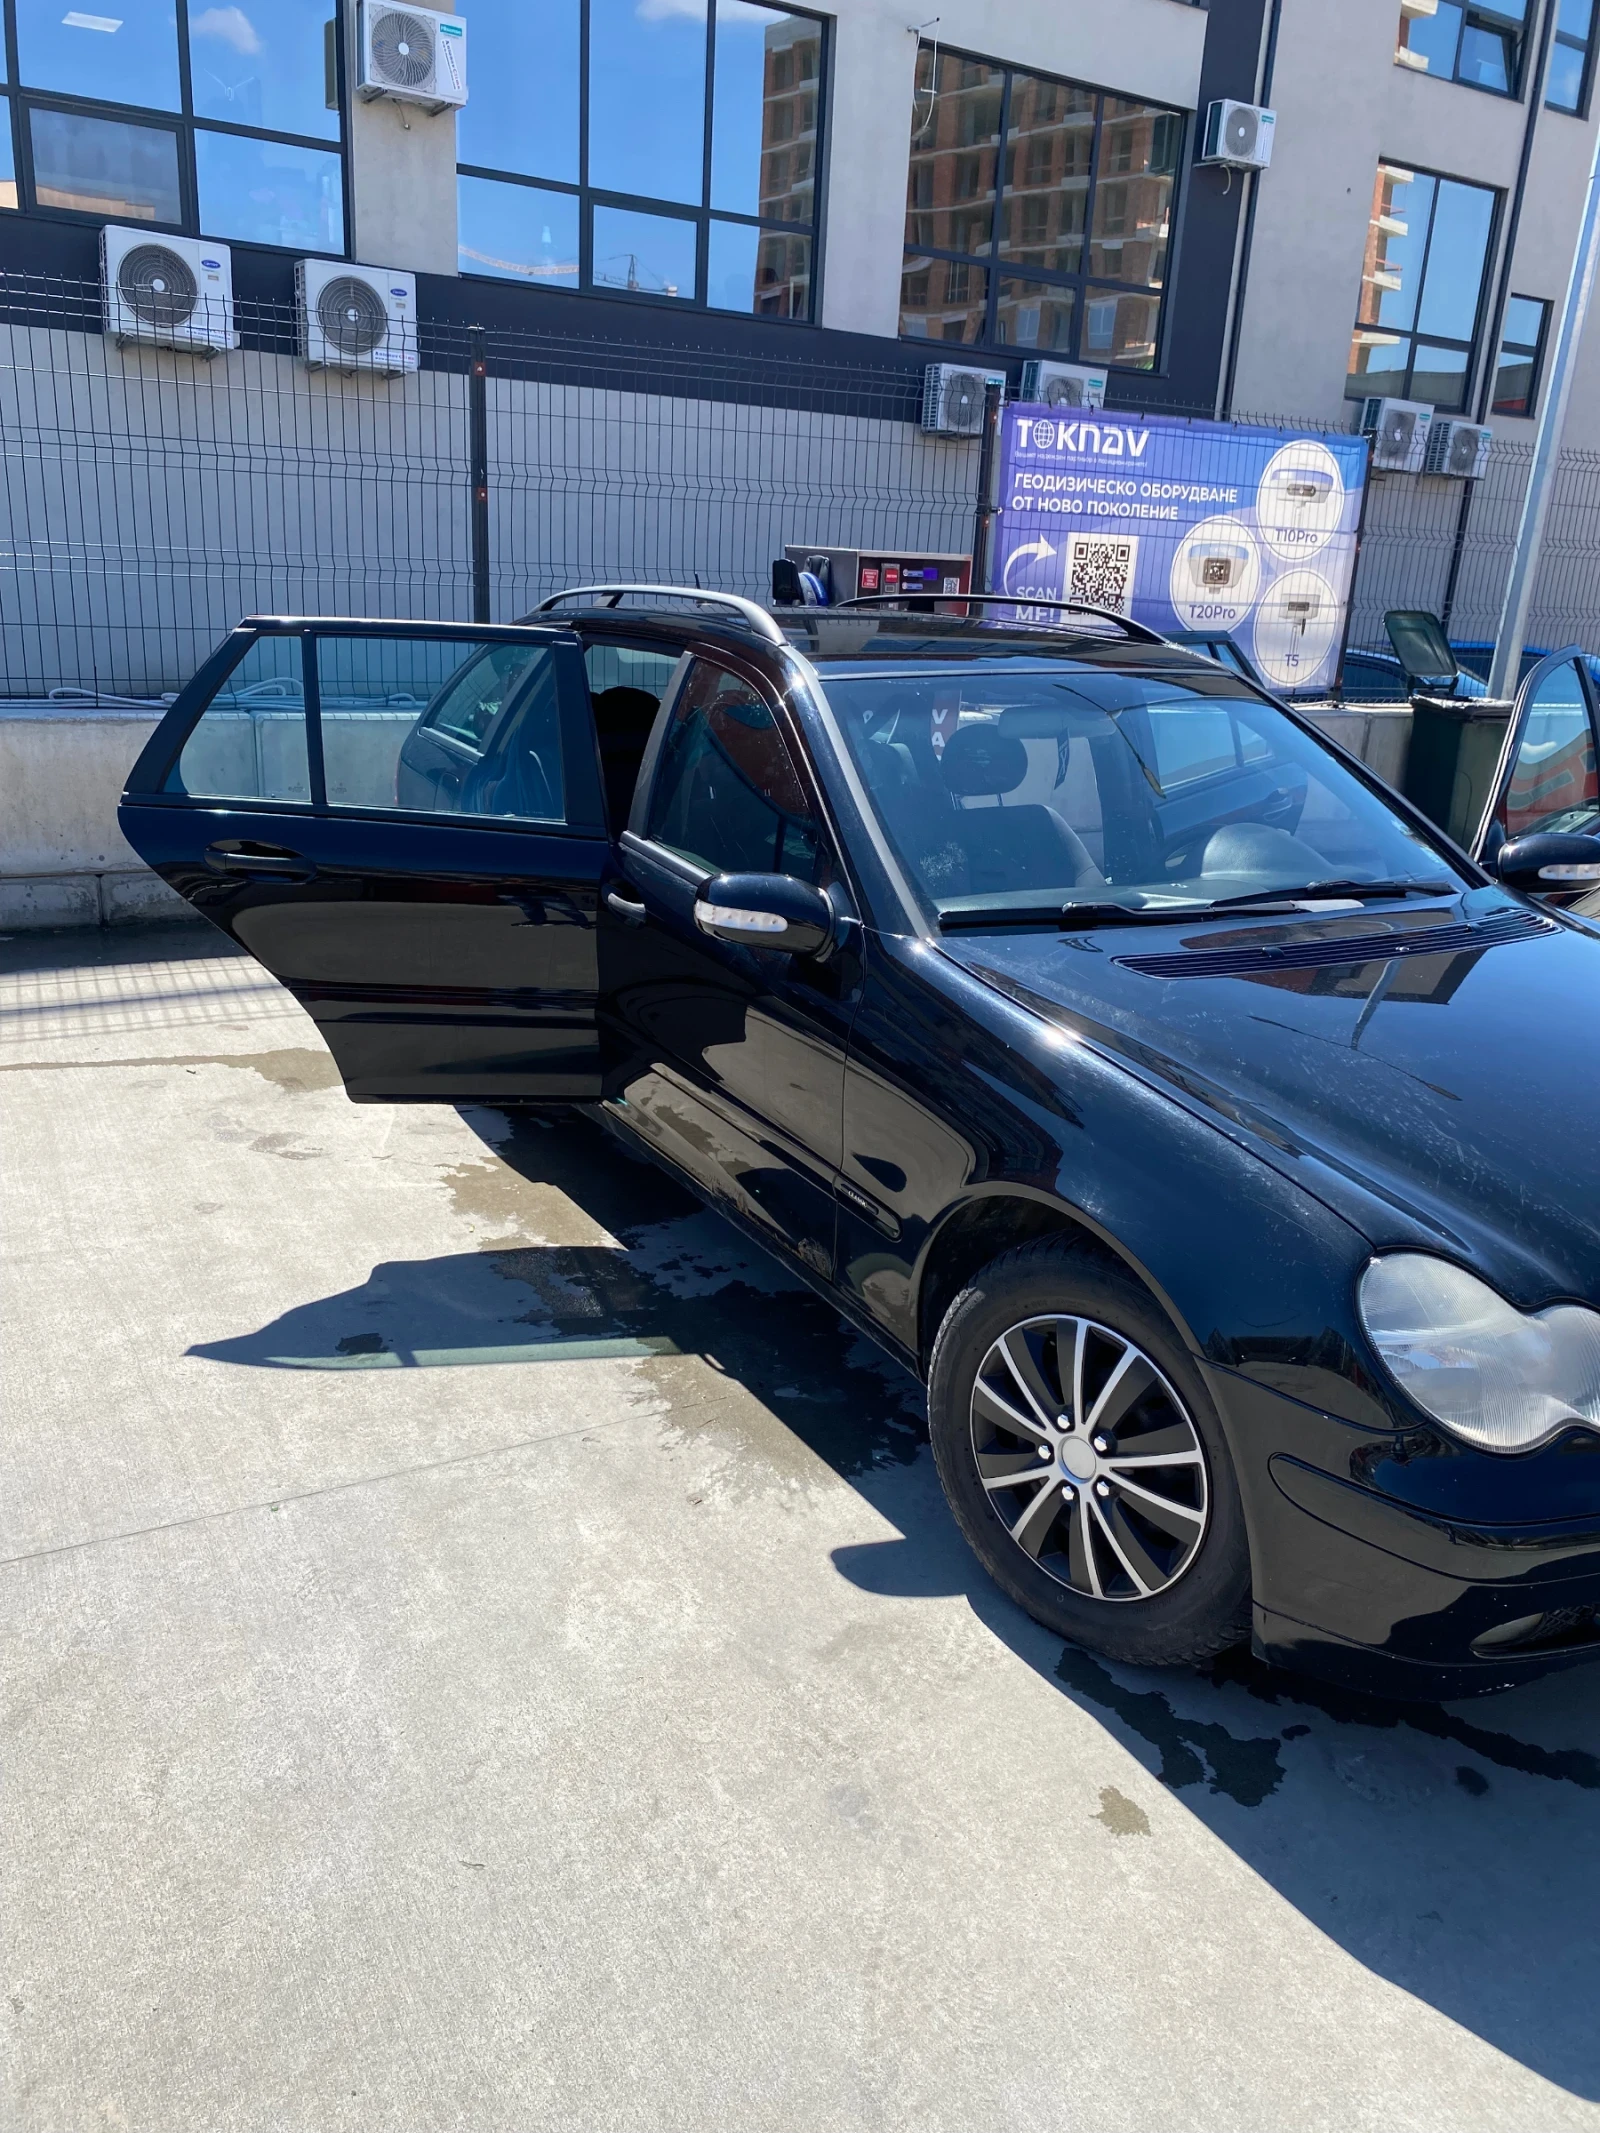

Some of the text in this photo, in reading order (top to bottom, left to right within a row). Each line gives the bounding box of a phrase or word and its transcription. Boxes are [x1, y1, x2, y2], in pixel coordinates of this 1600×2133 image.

[1014, 473, 1238, 503] ГЕОДИЗИЧЕСКО ОБОРУДВАНЕ
[1012, 496, 1178, 520] ОТ НОВО ПОКОЛЕНИЕ
[1275, 528, 1318, 544] T10Pro
[1016, 586, 1057, 600] SCAN
[1189, 604, 1236, 619] T20Pro
[1285, 653, 1299, 667] T5
